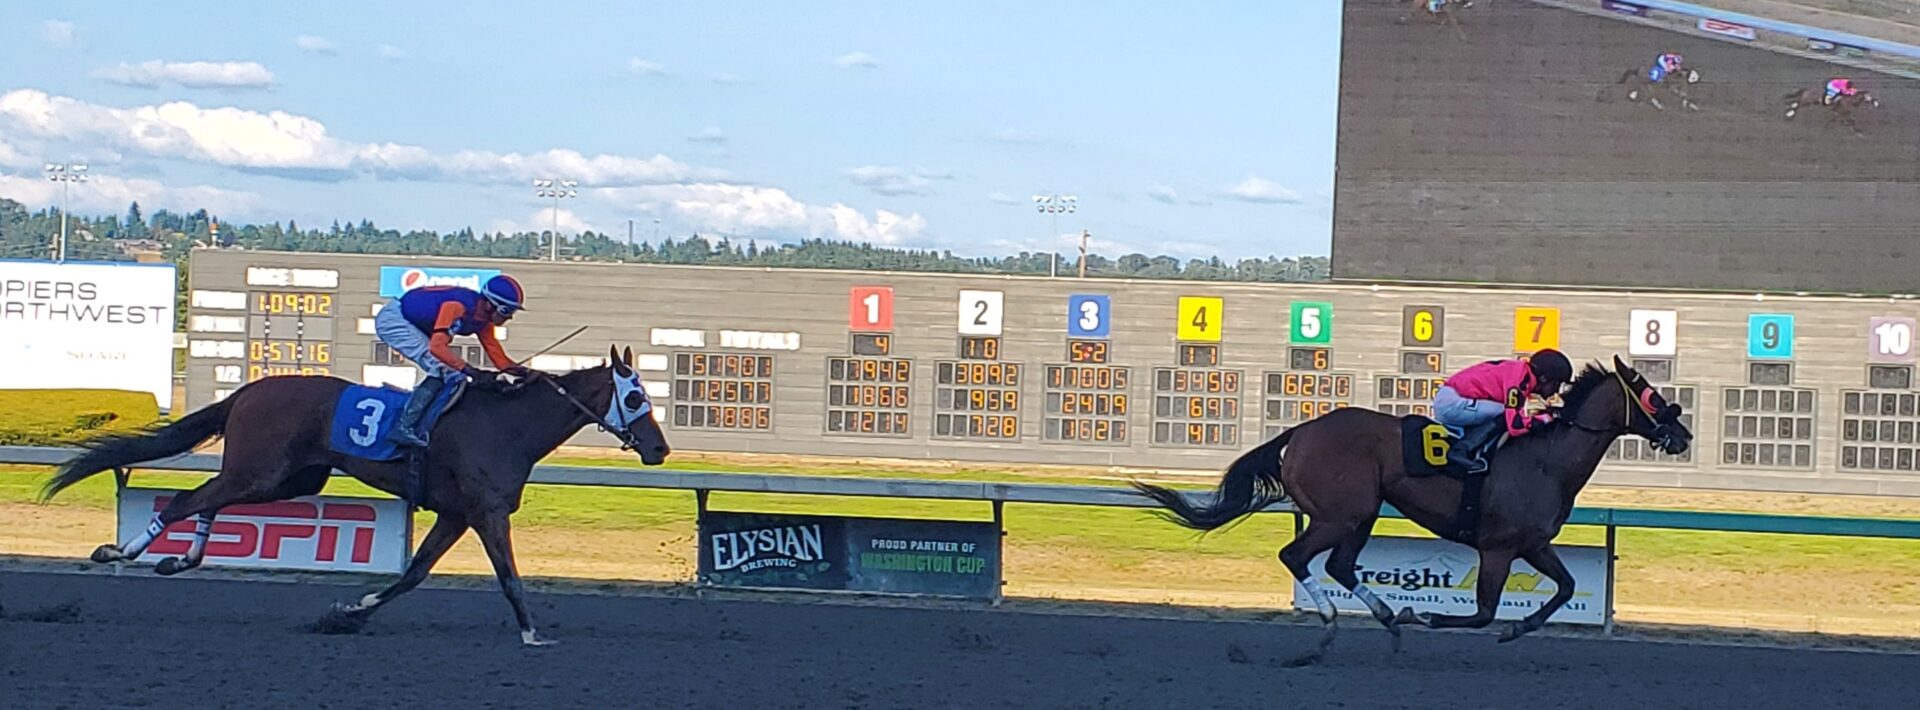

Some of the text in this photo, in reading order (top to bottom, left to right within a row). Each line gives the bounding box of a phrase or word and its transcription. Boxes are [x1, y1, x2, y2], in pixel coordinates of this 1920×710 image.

[0, 280, 97, 300] PIERS
[0, 302, 167, 324] RTHWEST
[863, 293, 880, 324] 1
[974, 300, 989, 325] 2
[1079, 301, 1099, 330] 3
[1192, 306, 1208, 332] 4
[1301, 307, 1321, 338] 5
[1414, 311, 1434, 341] 6
[1529, 316, 1546, 343] 7
[1645, 319, 1661, 346] 8
[1763, 322, 1779, 350] 9
[1875, 323, 1911, 355] 10
[969, 338, 997, 358] 10
[1313, 350, 1327, 369] 6
[1427, 353, 1440, 372] 9
[957, 364, 1017, 385] 3892
[1176, 371, 1237, 392] 3450
[853, 386, 908, 407] 1866
[1284, 375, 1350, 397] 6220
[972, 390, 1016, 410] 959
[1063, 394, 1126, 414] 2479
[1190, 397, 1236, 418] 697
[1508, 388, 1519, 408] 6
[350, 398, 386, 447] 3
[972, 416, 1016, 436] 728
[1422, 424, 1450, 466] 6
[146, 496, 376, 563] ESPN
[712, 524, 823, 570] ELYSIAN
[872, 539, 976, 553] PROUD PARTNER OF
[740, 558, 798, 573] BREWING
[861, 553, 985, 574] WASHINGTON CUP
[1354, 564, 1453, 591] reight
[1385, 592, 1444, 604] Small,
